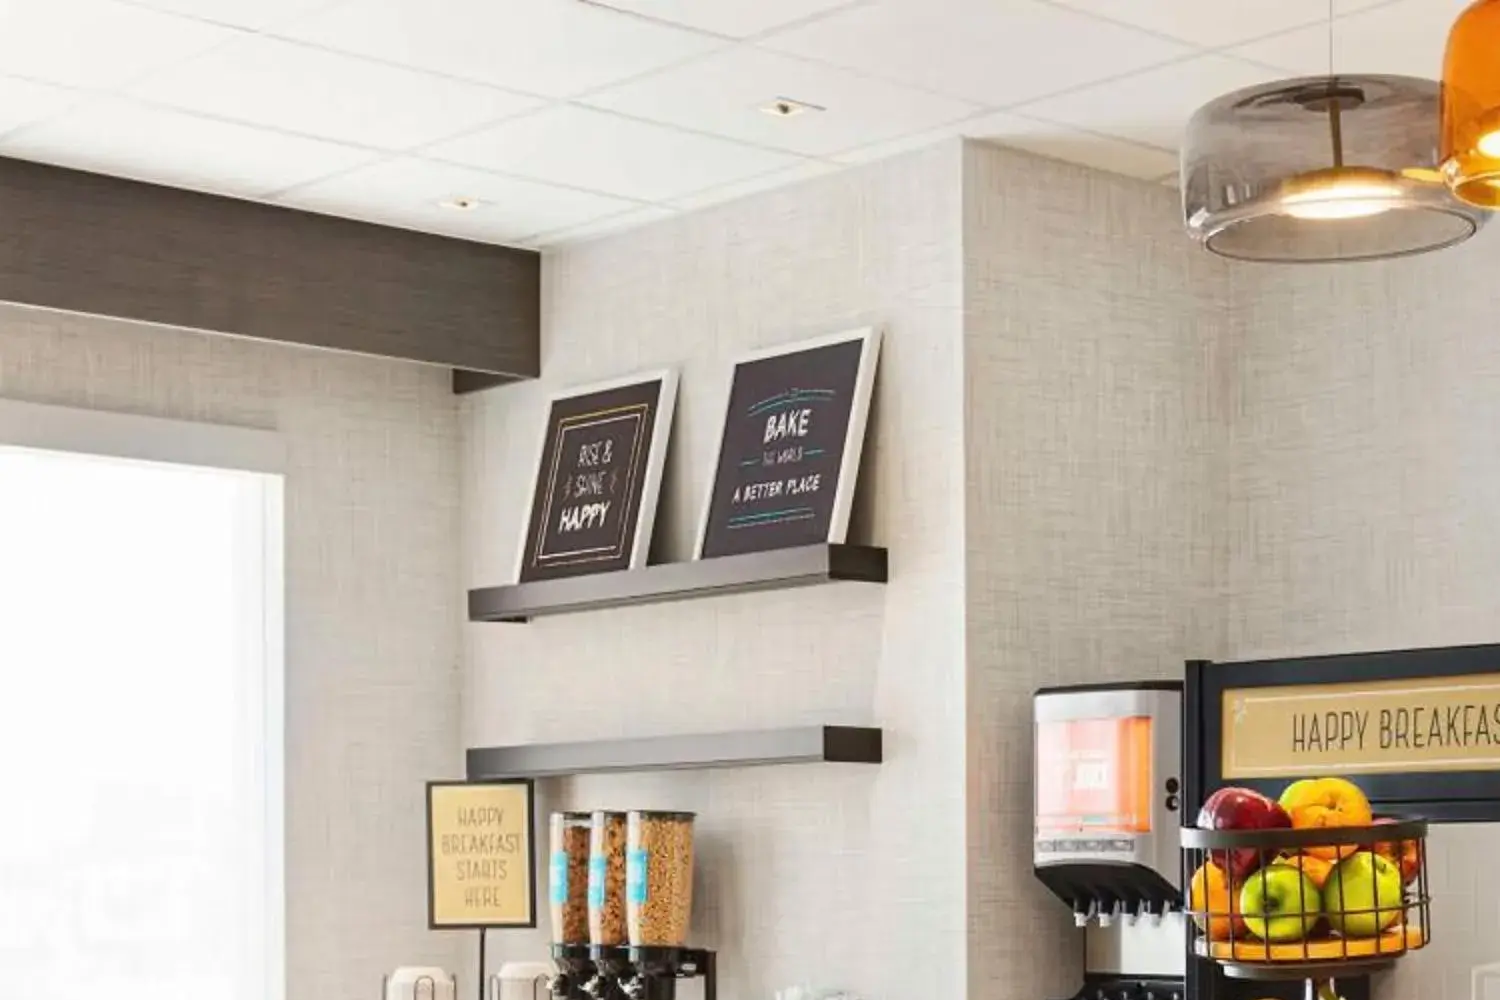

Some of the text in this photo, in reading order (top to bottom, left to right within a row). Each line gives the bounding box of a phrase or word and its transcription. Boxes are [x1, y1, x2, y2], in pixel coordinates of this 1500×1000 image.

[763, 408, 812, 444] BAKE
[731, 474, 821, 504] A BETTER PLACE
[558, 500, 612, 534] HAPPY
[1292, 709, 1370, 753] HAPPY
[457, 806, 504, 828] HAPPY
[441, 832, 522, 857] BREAKFAST
[456, 859, 508, 881] STARTS
[465, 885, 502, 908] HERE
